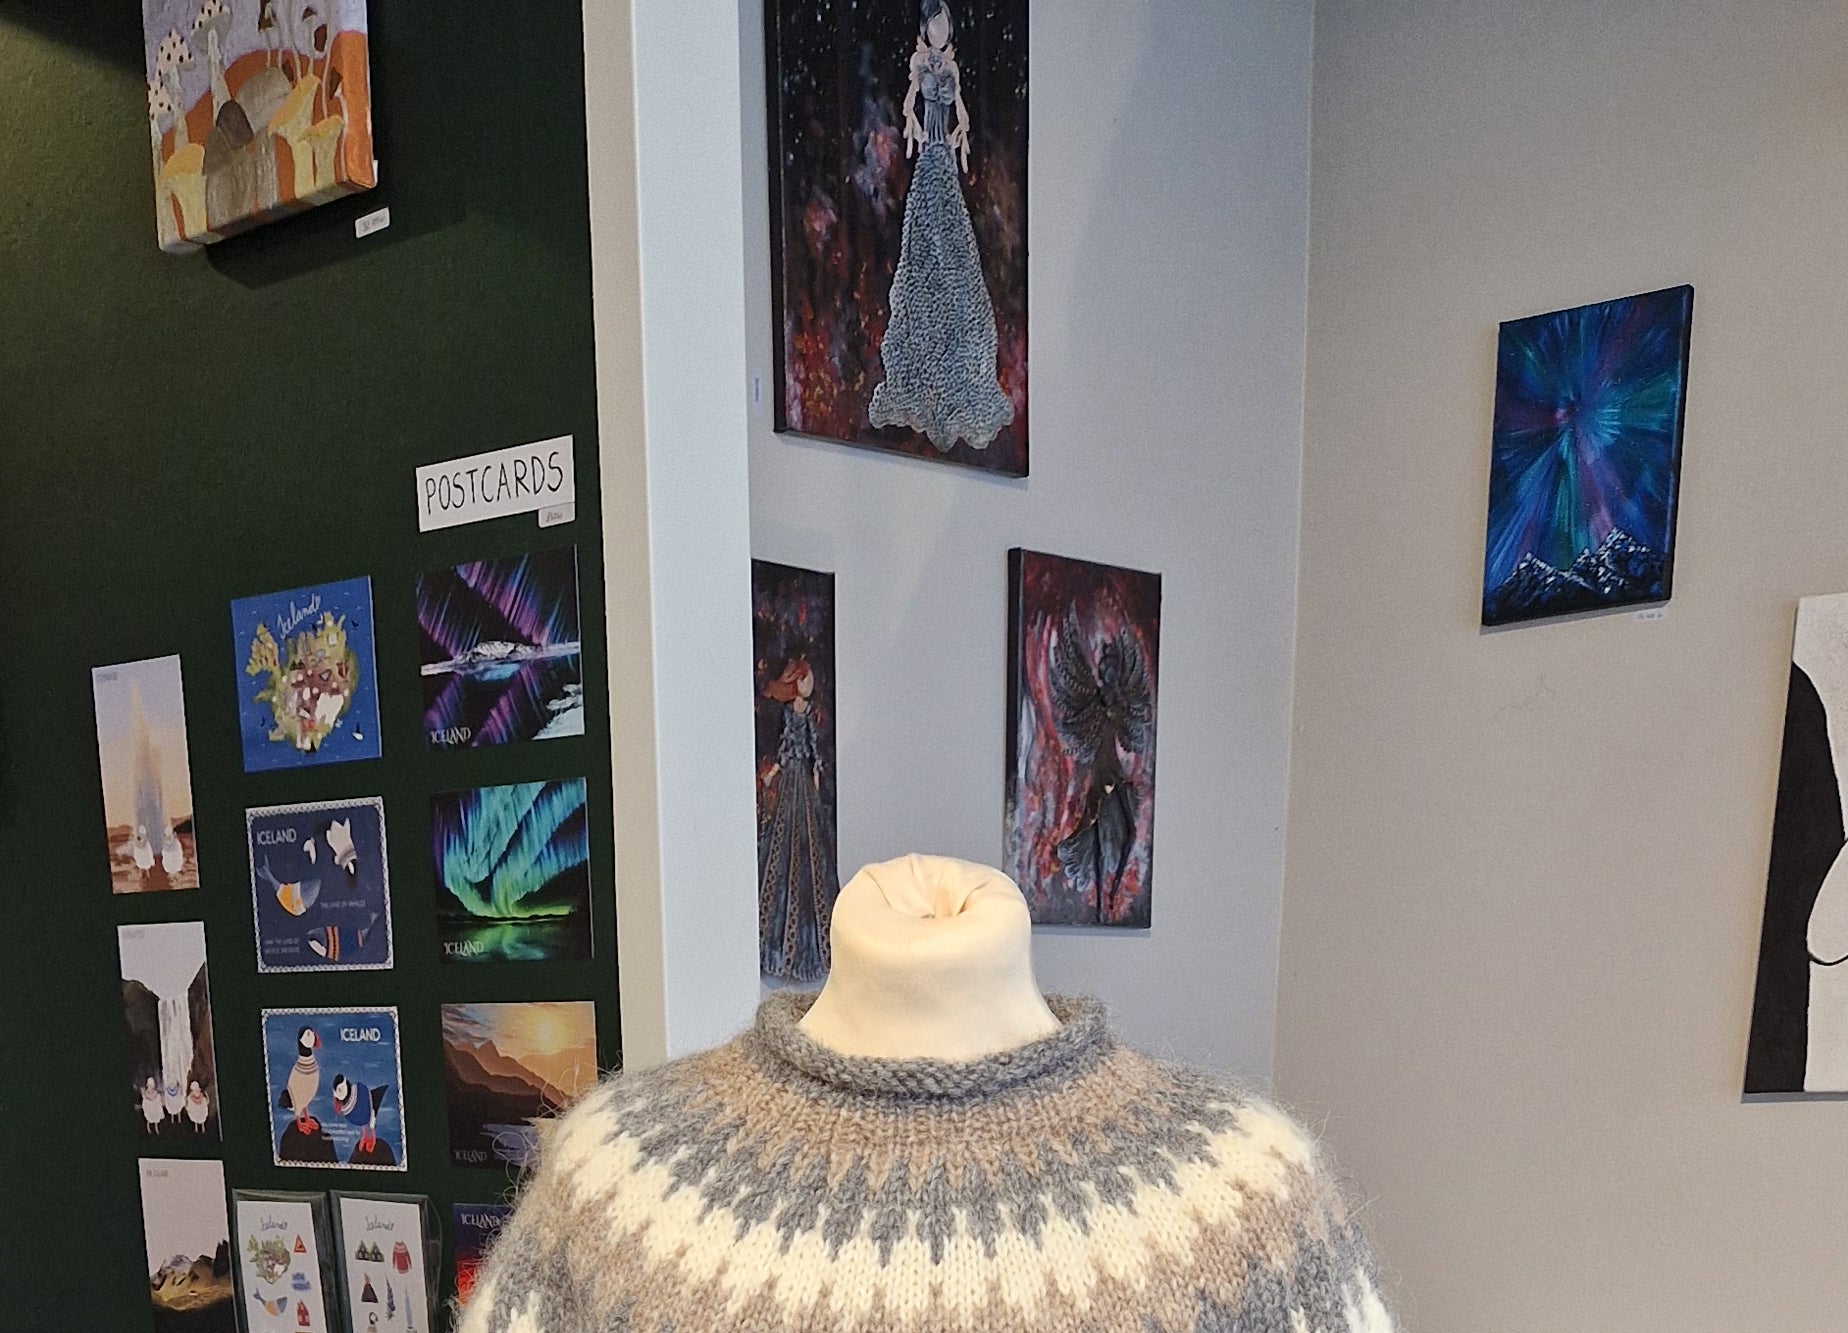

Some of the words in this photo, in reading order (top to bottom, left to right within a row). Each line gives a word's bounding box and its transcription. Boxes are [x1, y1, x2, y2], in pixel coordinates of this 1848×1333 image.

[425, 451, 564, 515] POSTCARDS
[277, 593, 321, 640] Iceland
[430, 726, 472, 745] ICELAND
[256, 828, 297, 846] ICELAND
[443, 939, 485, 957] ICELAND
[340, 1027, 382, 1042] ICELAND
[460, 1213, 501, 1229] ICELAND
